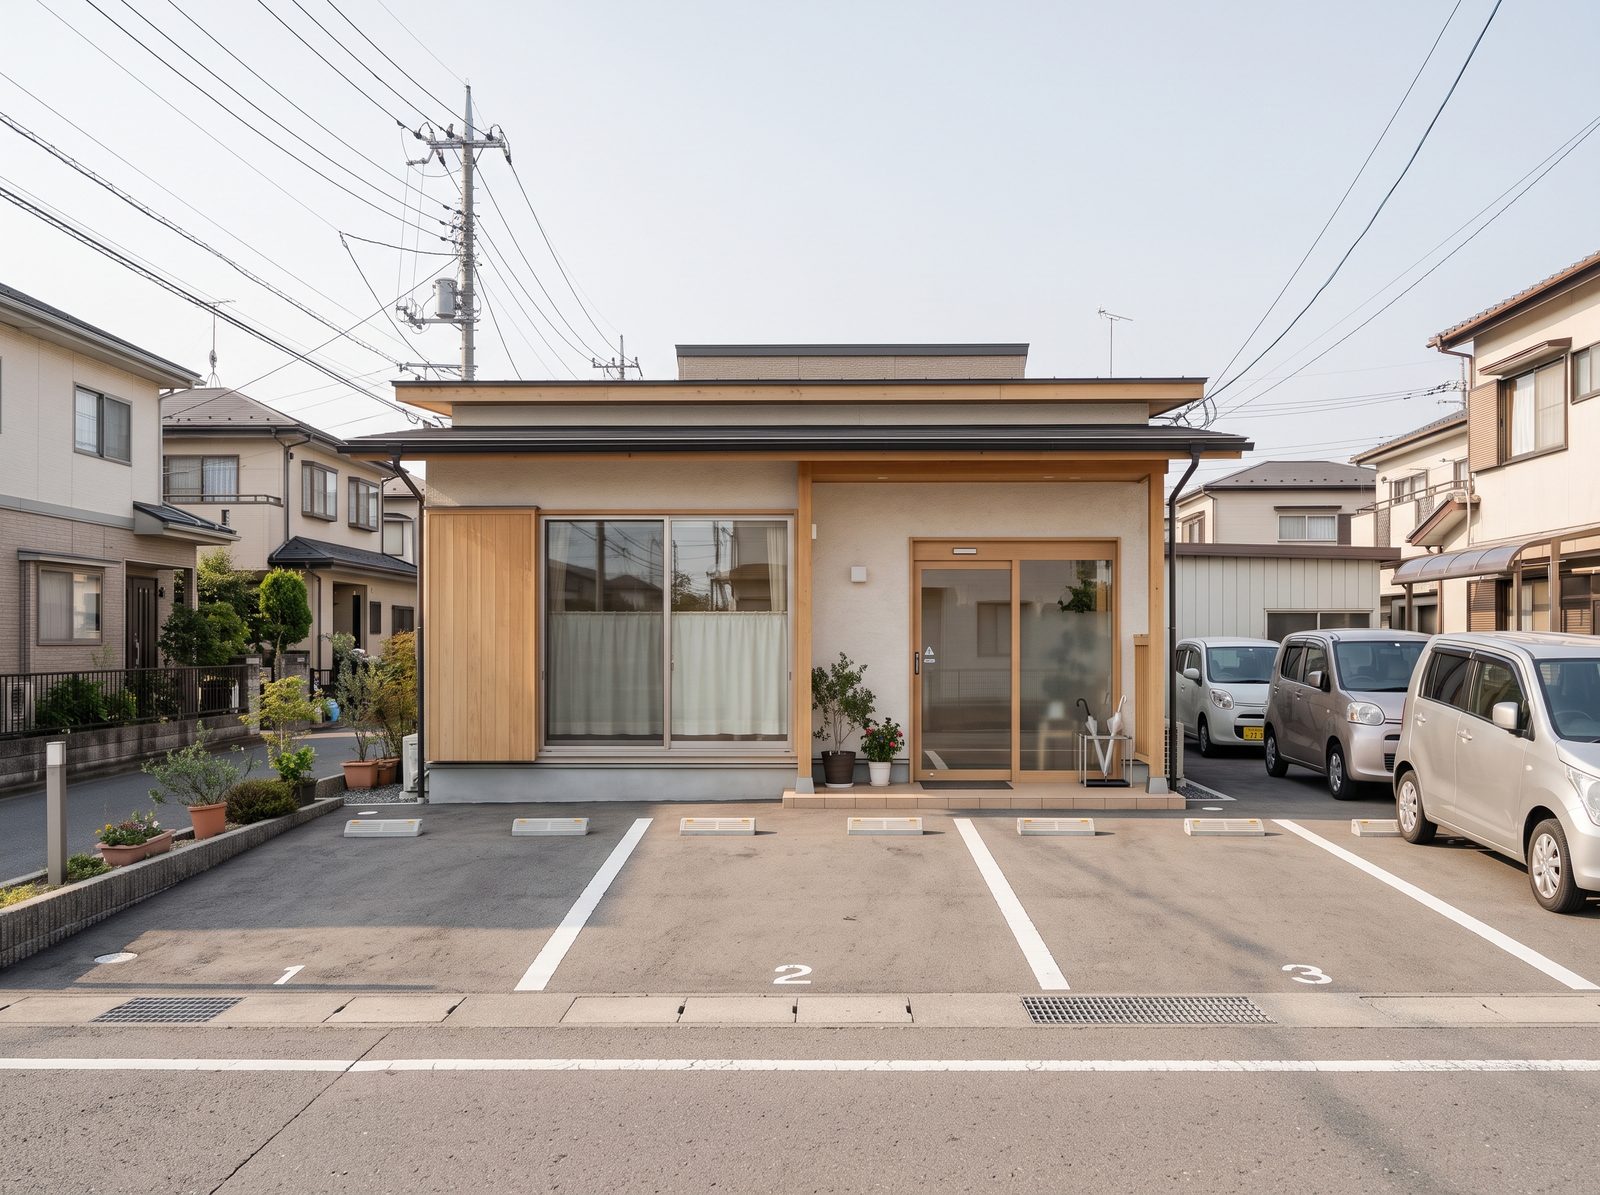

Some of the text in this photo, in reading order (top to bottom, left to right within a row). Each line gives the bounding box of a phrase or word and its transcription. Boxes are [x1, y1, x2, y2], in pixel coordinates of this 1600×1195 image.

[273, 965, 305, 985] 1
[773, 964, 812, 984] 2
[1281, 964, 1332, 984] 3
